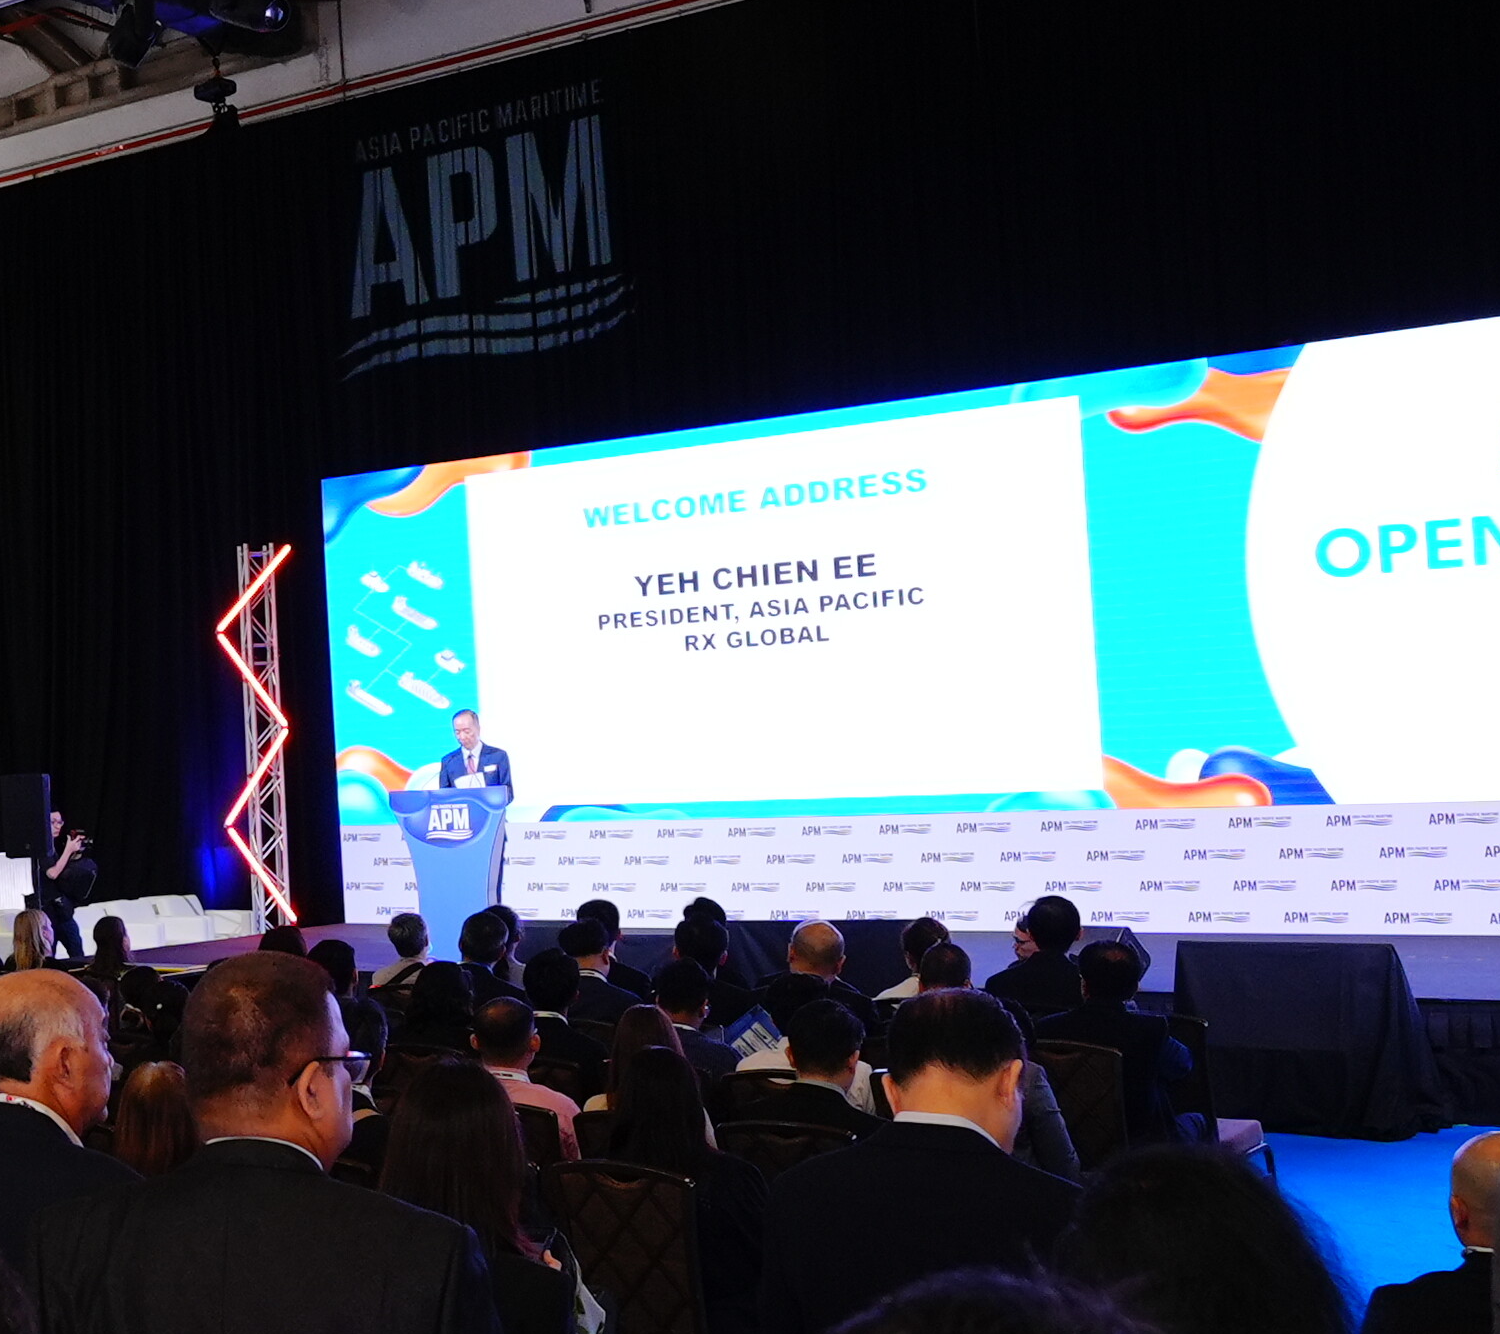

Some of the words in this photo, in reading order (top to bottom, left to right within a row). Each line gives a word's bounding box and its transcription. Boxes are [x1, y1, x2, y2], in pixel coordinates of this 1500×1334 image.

[409, 107, 490, 152] PACIFIC
[350, 113, 614, 320] APM
[583, 489, 747, 529] WELCOME
[761, 469, 928, 509] ADDRESS
[635, 572, 700, 598] YEH
[713, 560, 819, 591] CHIEN
[834, 554, 877, 581] EE
[598, 605, 740, 631] PRESIDENT,
[749, 599, 810, 618] ASIA
[819, 588, 925, 613] PACIFIC
[684, 636, 717, 651] RX
[727, 625, 830, 650] GLOBAL
[428, 808, 470, 830] APM
[1229, 818, 1252, 827] APM
[1327, 816, 1351, 826] APM
[1429, 814, 1455, 824] APM
[1041, 822, 1062, 831] APM
[1136, 820, 1157, 829] APM
[1001, 852, 1021, 861] APM
[1087, 851, 1108, 860] APM
[1184, 850, 1206, 859] APM
[1280, 848, 1303, 858] APM
[1380, 847, 1404, 857] APM
[1140, 881, 1162, 890] APM
[1234, 881, 1256, 890] APM
[1331, 880, 1355, 890] APM
[1434, 880, 1460, 890] APM
[1091, 912, 1112, 921] APM
[1189, 912, 1211, 921] APM
[1285, 912, 1308, 922] APM
[1385, 913, 1409, 923] APM
